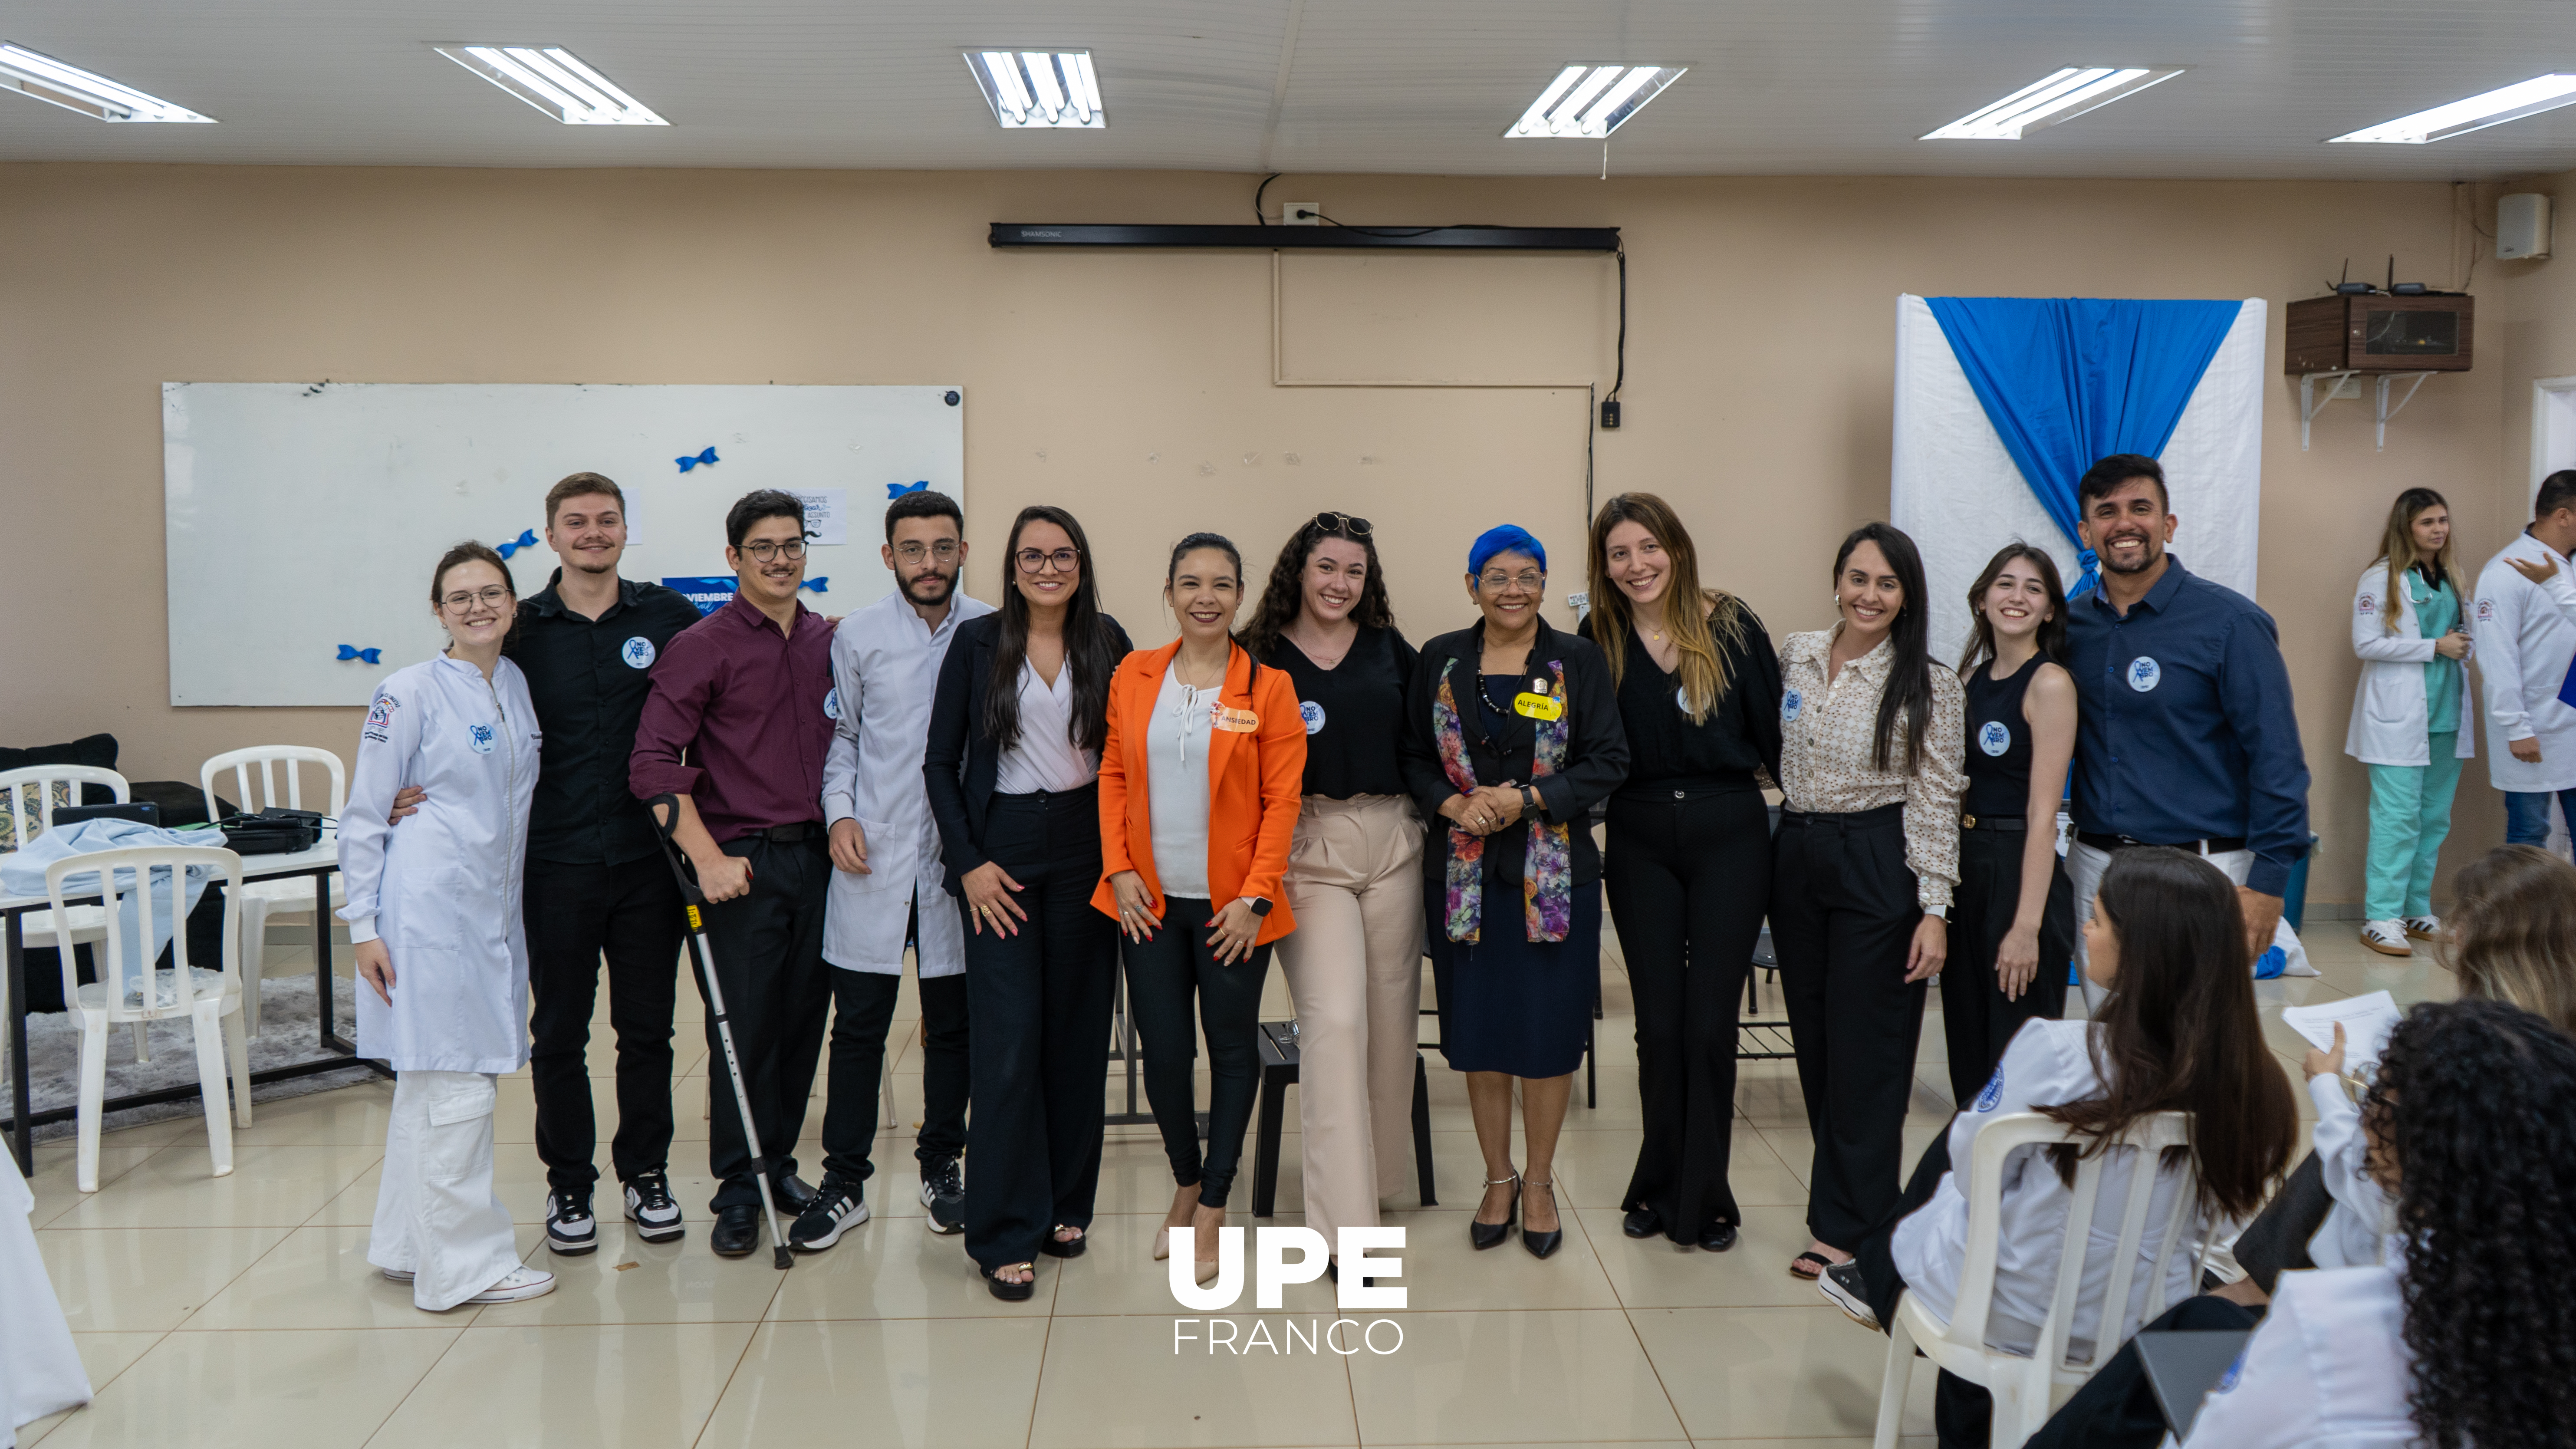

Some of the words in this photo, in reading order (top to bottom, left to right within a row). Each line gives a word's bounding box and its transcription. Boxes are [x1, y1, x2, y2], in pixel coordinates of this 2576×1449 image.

[682, 592, 734, 602] VIEMBRE
[1517, 699, 1549, 711] ALEGRÍA
[1221, 716, 1256, 725] ANSIEDAD
